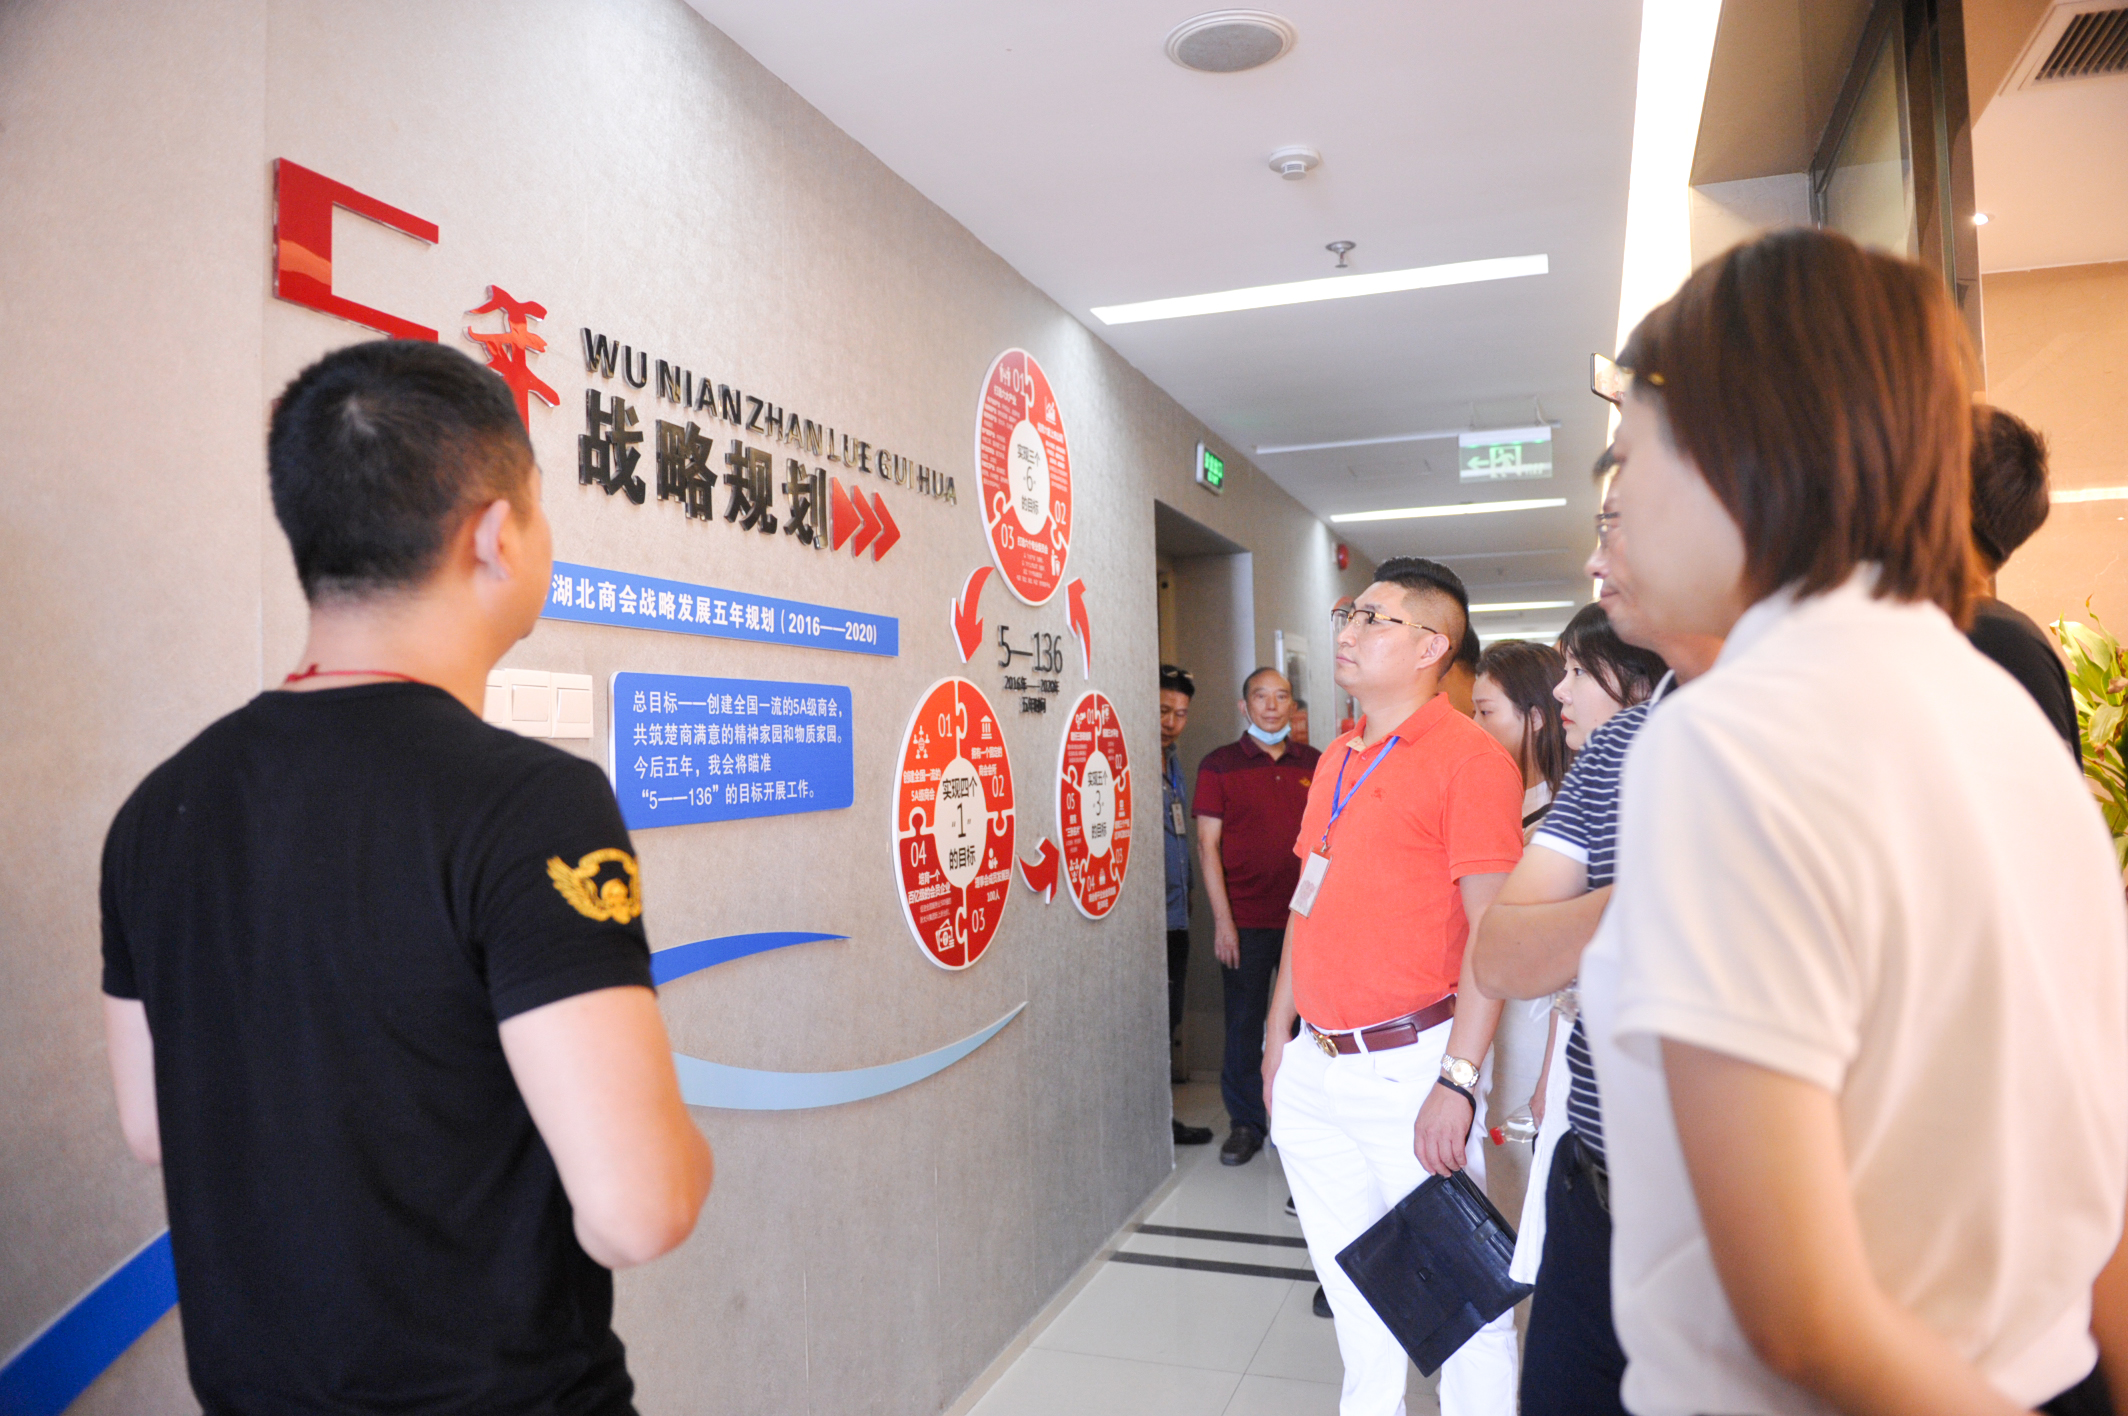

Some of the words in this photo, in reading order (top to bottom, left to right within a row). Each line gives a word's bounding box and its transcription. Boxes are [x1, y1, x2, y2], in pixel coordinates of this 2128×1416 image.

[580, 328, 647, 389] WU
[578, 388, 829, 550] 战略规划
[1054, 500, 1067, 525] 02
[1001, 523, 1015, 549] 03
[938, 713, 953, 738] 01
[942, 776, 978, 801] 实现四个
[991, 774, 1005, 799] 02
[910, 840, 927, 868] 04
[949, 847, 976, 871] 的目标
[971, 907, 986, 933] 03
